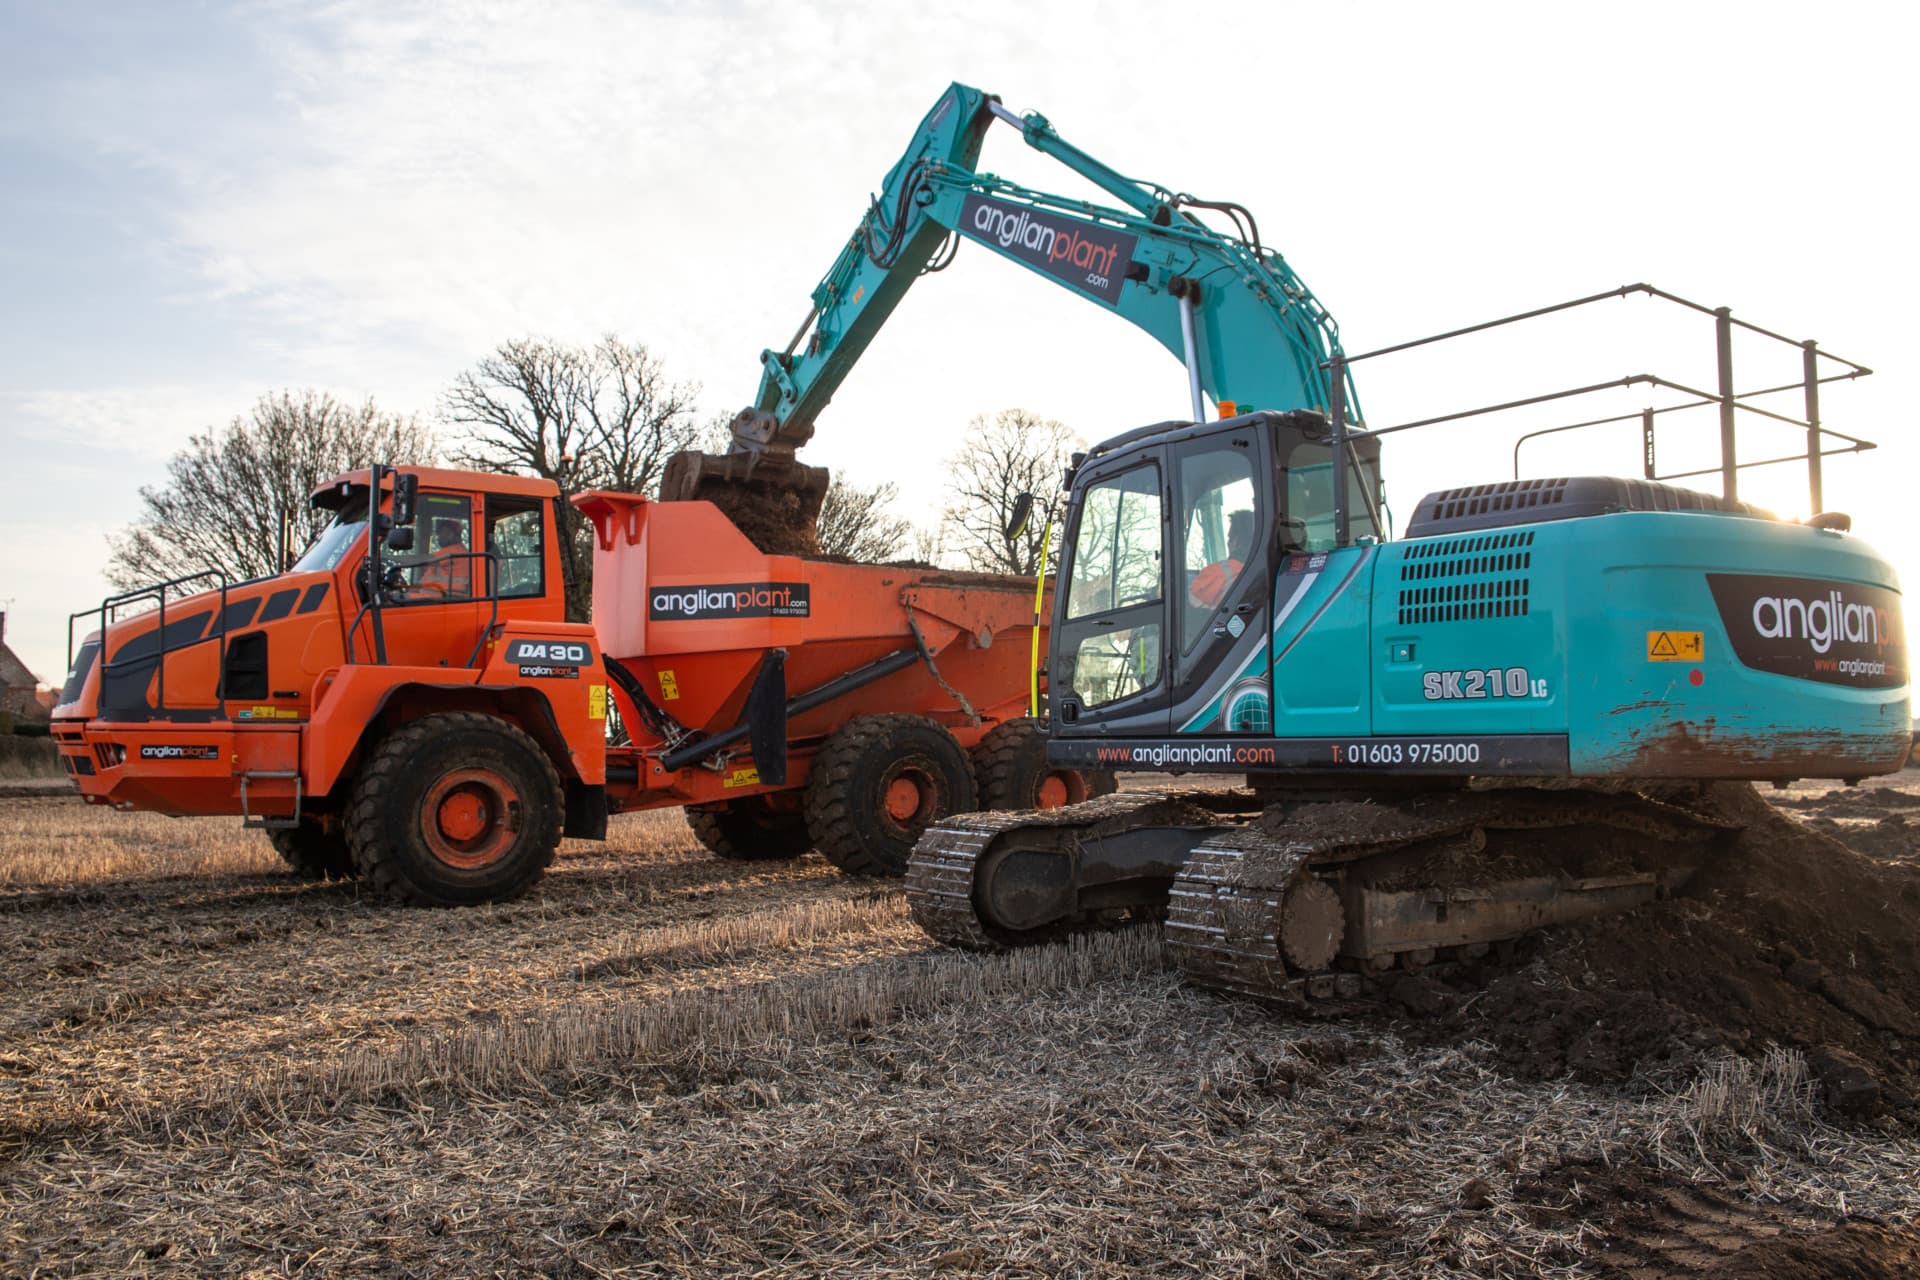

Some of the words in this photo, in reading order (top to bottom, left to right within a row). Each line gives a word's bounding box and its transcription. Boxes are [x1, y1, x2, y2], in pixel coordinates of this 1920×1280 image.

[974, 204, 1118, 276] anglianplant
[1085, 272, 1110, 289] .com
[518, 643, 547, 658] DA
[549, 645, 584, 661] 30
[1422, 667, 1530, 701] SK210
[1531, 679, 1548, 698] LC
[1097, 743, 1275, 766] www.anglianplant.com
[1331, 745, 1344, 764] T:
[1348, 744, 1403, 763] 01603
[1408, 743, 1480, 763] 975000
